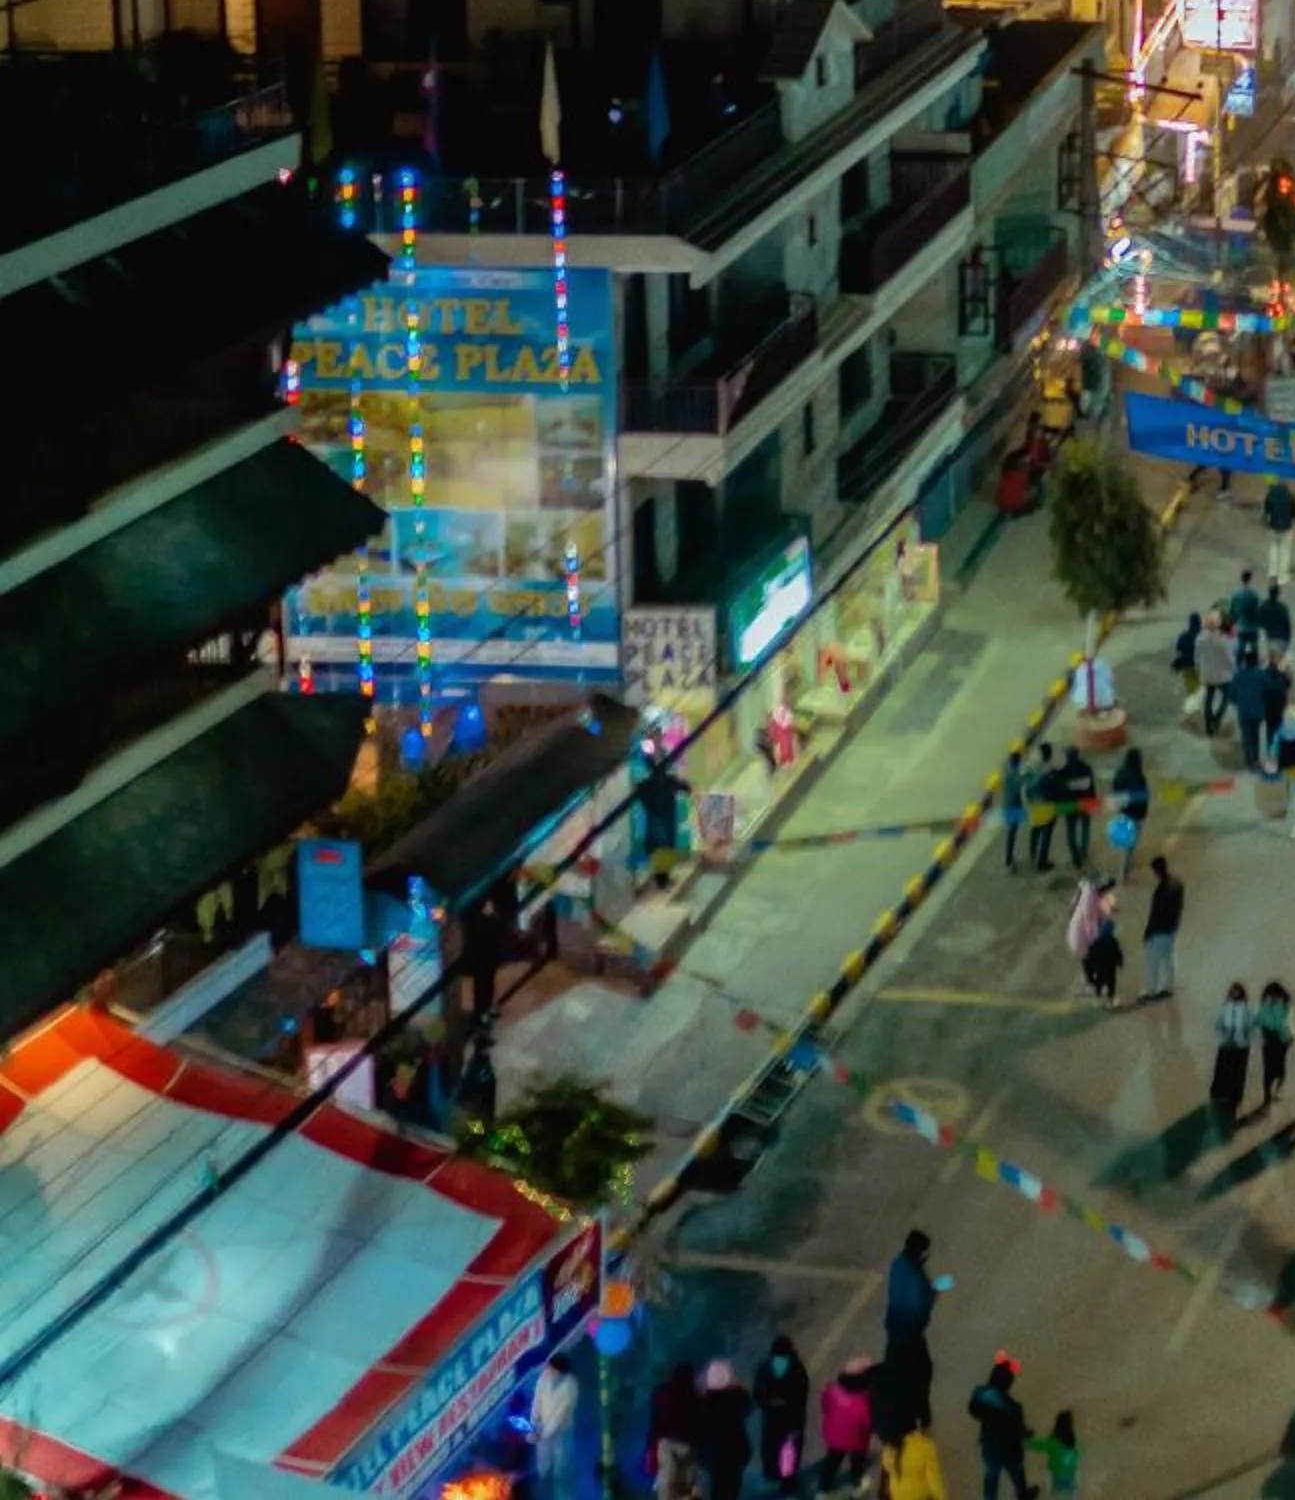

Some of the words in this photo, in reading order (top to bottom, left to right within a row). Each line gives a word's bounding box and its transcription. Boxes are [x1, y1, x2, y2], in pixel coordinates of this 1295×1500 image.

[362, 297, 524, 335] HOTEL
[291, 341, 442, 381] PEACE
[456, 344, 600, 383] PLAZA
[623, 617, 706, 639] HOTEL
